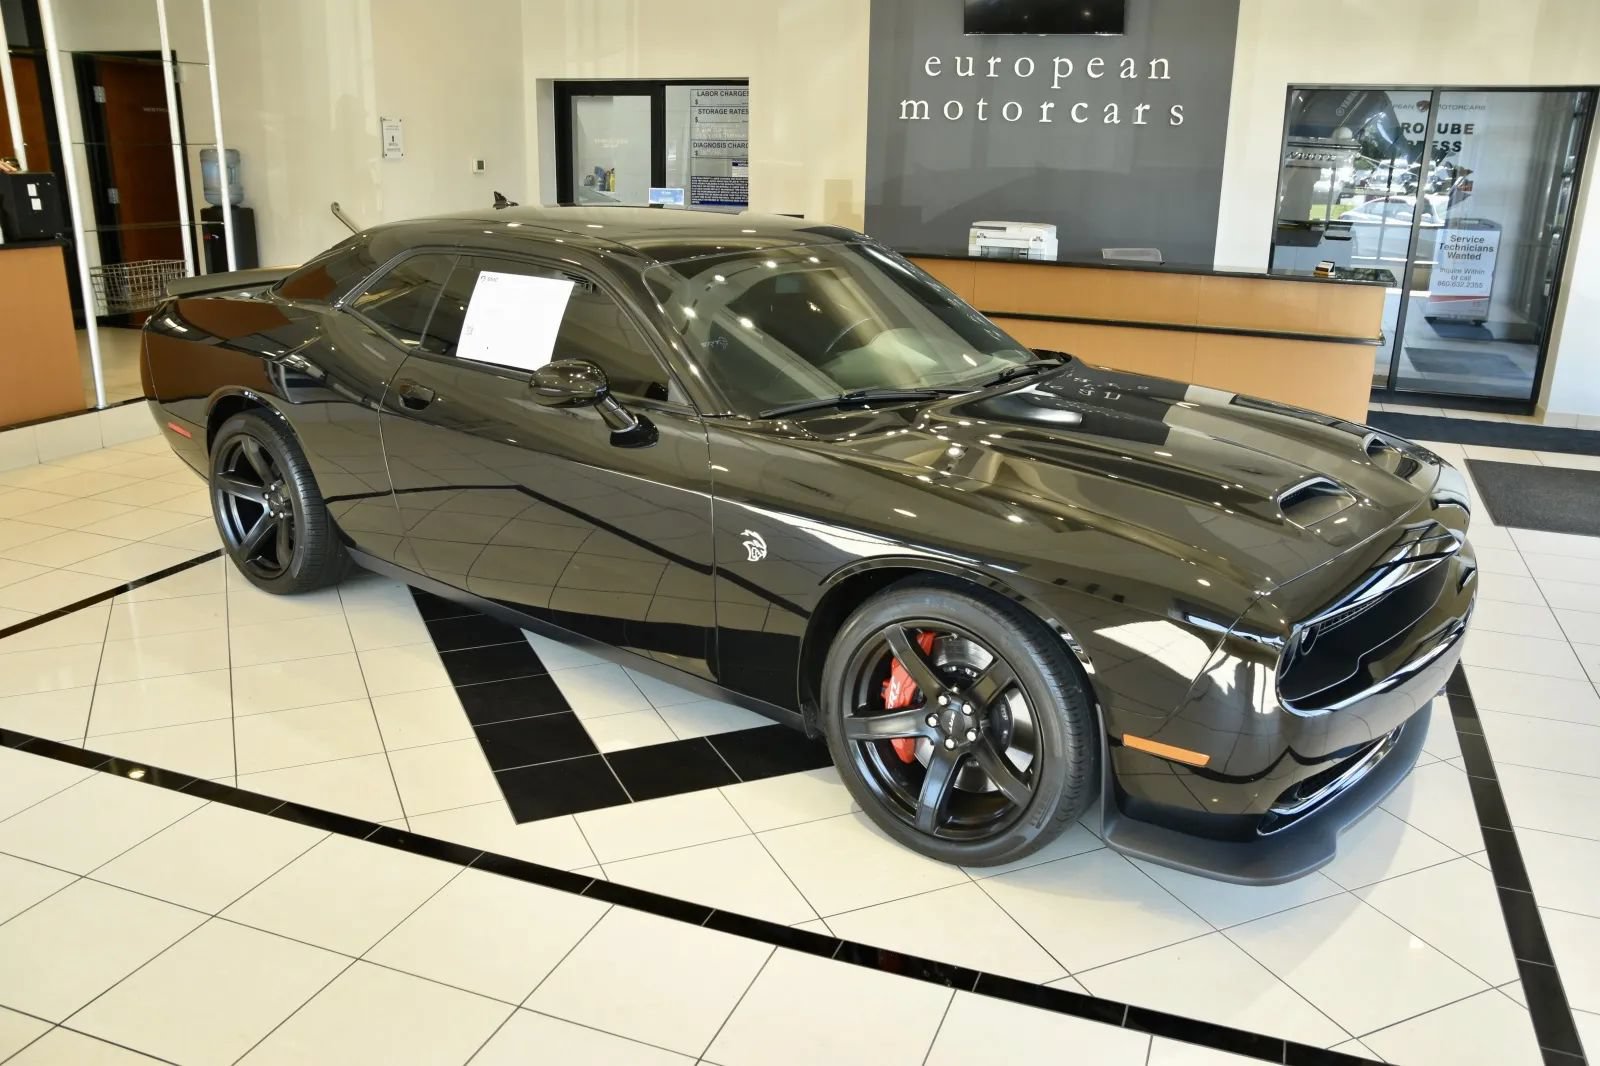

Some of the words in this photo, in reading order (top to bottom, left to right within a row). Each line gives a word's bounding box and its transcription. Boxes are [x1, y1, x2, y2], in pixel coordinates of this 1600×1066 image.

[924, 54, 1172, 89] european
[898, 97, 1185, 126] motorcars
[1450, 234, 1485, 243] Service
[1439, 242, 1494, 253] Technicians
[1447, 251, 1482, 260] Wanted
[1464, 267, 1485, 275] Within
